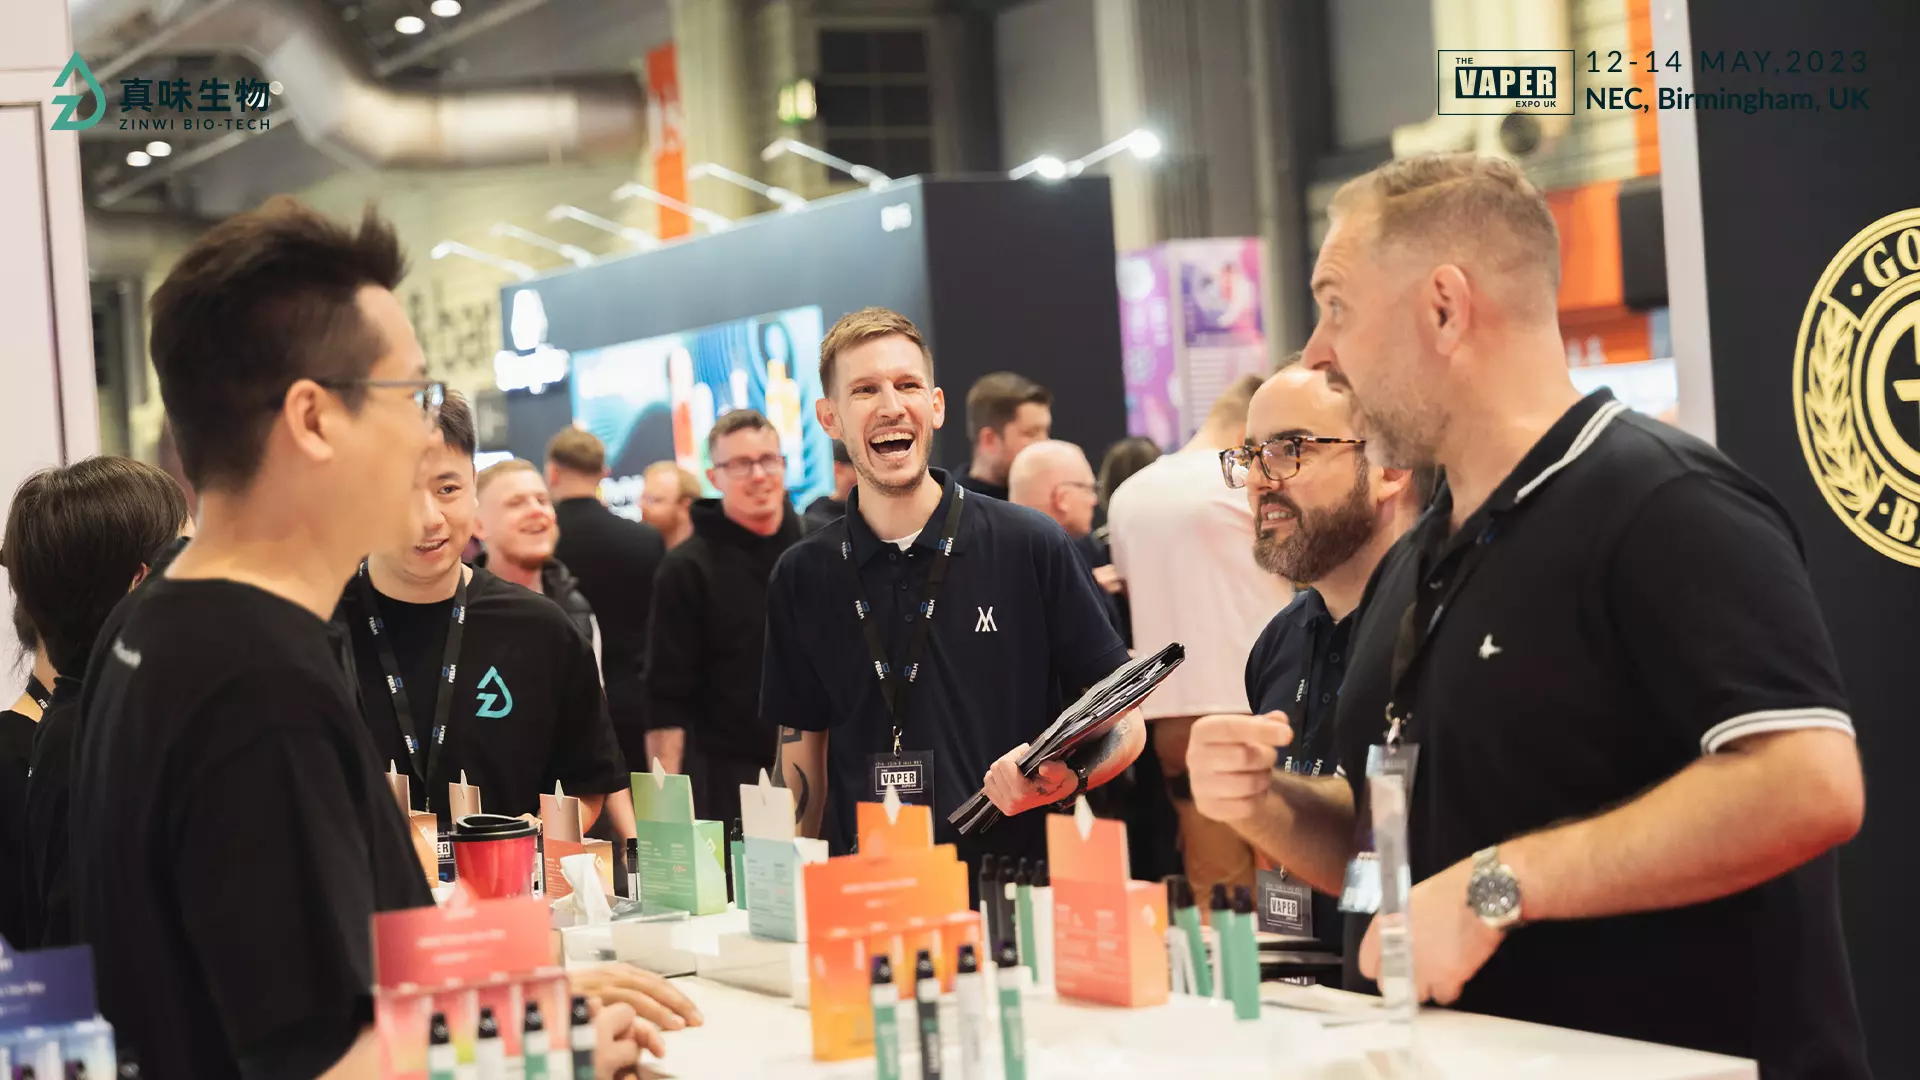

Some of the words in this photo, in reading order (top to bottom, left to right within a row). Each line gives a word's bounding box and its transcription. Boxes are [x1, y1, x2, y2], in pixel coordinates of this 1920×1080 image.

[1886, 496, 1920, 549] B
[457, 605, 466, 625] FEELM
[854, 599, 865, 620] FEELM
[925, 599, 936, 620] FEELM
[448, 664, 457, 684] FEELM
[874, 660, 885, 681] FEELM
[909, 662, 919, 682] FEELM
[386, 674, 397, 694] FEELM
[404, 734, 415, 755] FEELM
[437, 724, 446, 745] FEELM
[882, 772, 915, 784] VAPER
[1271, 898, 1298, 917] VAPER
